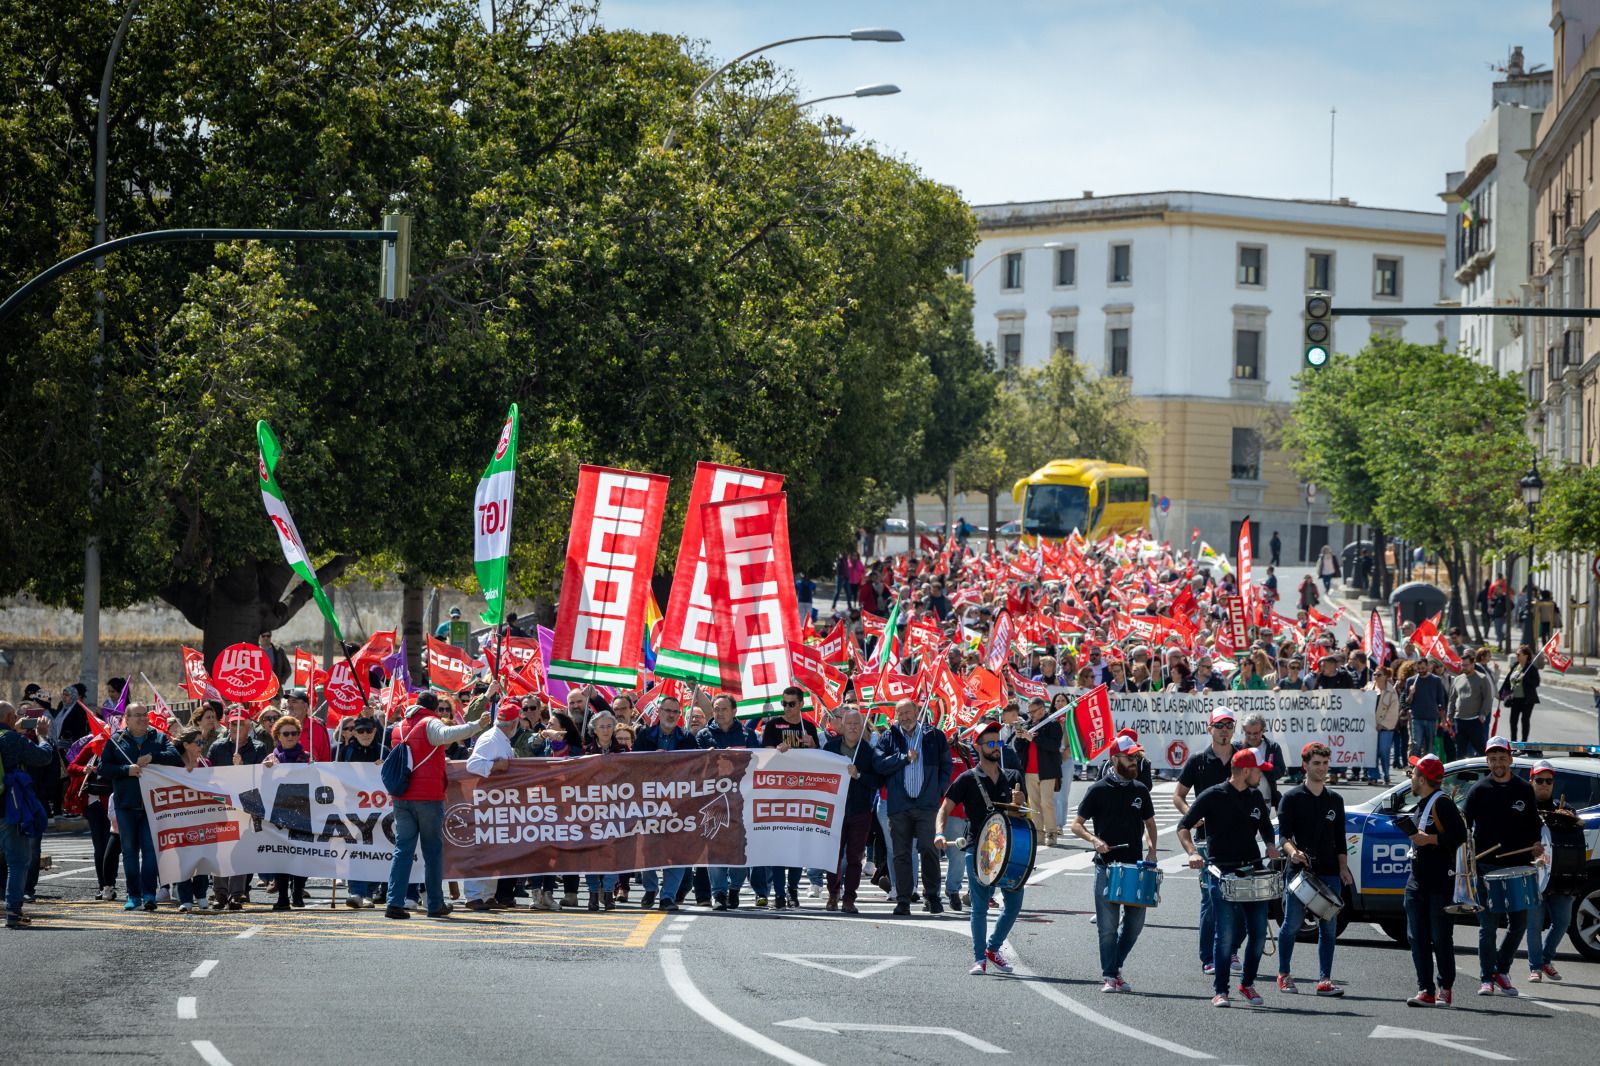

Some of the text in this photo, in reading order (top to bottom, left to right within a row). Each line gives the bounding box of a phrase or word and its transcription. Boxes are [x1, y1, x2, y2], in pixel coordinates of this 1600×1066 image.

[571, 472, 649, 666] CCOO
[719, 501, 791, 700] CCOO
[1230, 600, 1247, 647] CCOO
[222, 649, 263, 673] UGT
[1151, 697, 1162, 713] DE
[1163, 697, 1178, 713] LAS
[1179, 698, 1213, 713] GRANDES
[1280, 694, 1342, 710] COMERCIALES
[1131, 719, 1172, 734] APERTURA
[1175, 720, 1184, 735] DE
[1291, 718, 1303, 732] EN
[1307, 717, 1317, 732] EL
[1321, 717, 1365, 732] COMERCIO
[1328, 735, 1345, 746] NO
[1336, 751, 1365, 763] ZGAT
[757, 775, 785, 785] UGT
[473, 777, 738, 806] POR EL PLENO EMPLEO:
[474, 800, 679, 824] MENOS JORNADA,
[757, 803, 815, 817] CCOO
[475, 815, 697, 844] MEJORES SALARIOS
[772, 824, 805, 832] provincial
[160, 832, 185, 847] UGT
[257, 844, 339, 858] #PLENOEMPLEO
[341, 849, 348, 860] /
[1373, 863, 1413, 874] LOCA
